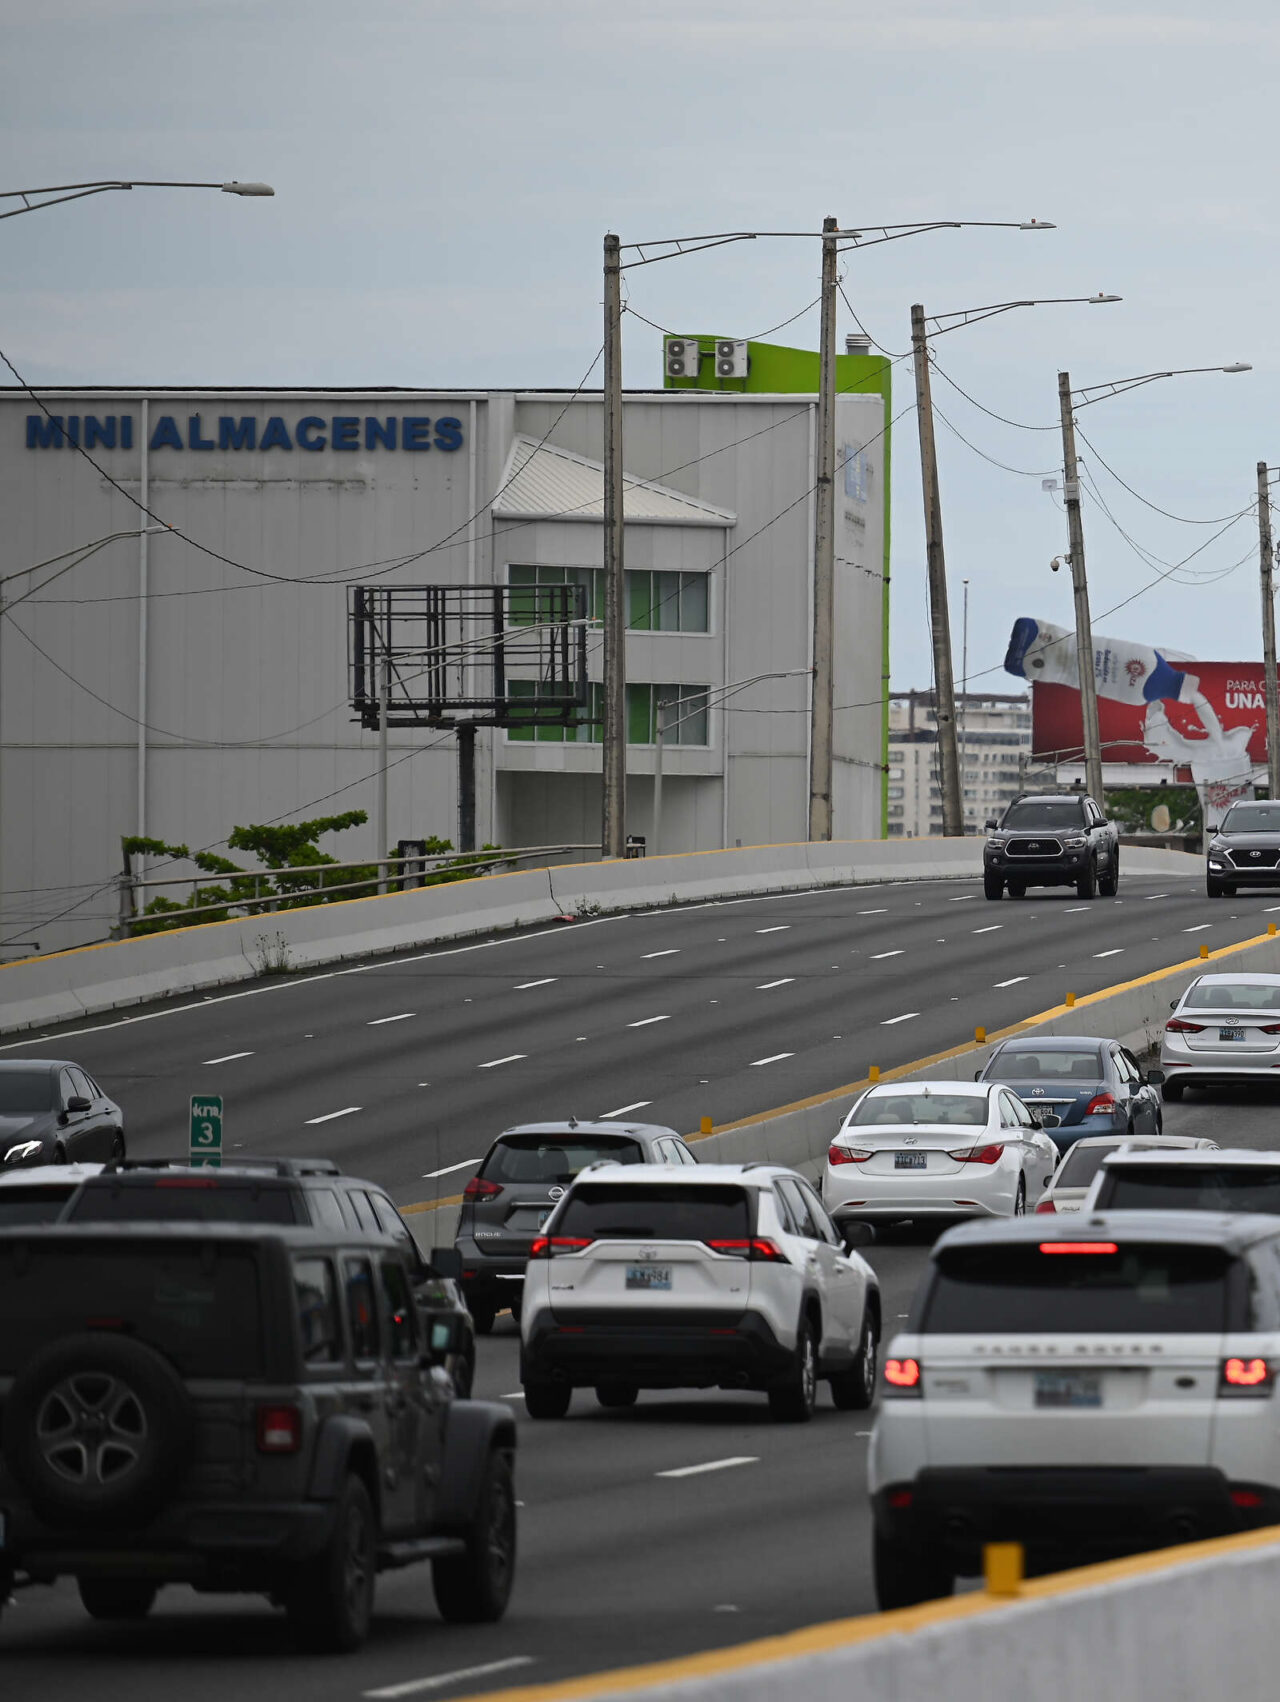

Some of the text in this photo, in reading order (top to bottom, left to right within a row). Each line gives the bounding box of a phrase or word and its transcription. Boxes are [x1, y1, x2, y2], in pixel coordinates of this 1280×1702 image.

[25, 415, 464, 451] MINI ALMACENES
[1227, 680, 1256, 691] PARA
[1226, 692, 1265, 709] UNA
[192, 1103, 219, 1117] km
[198, 1122, 213, 1144] 3
